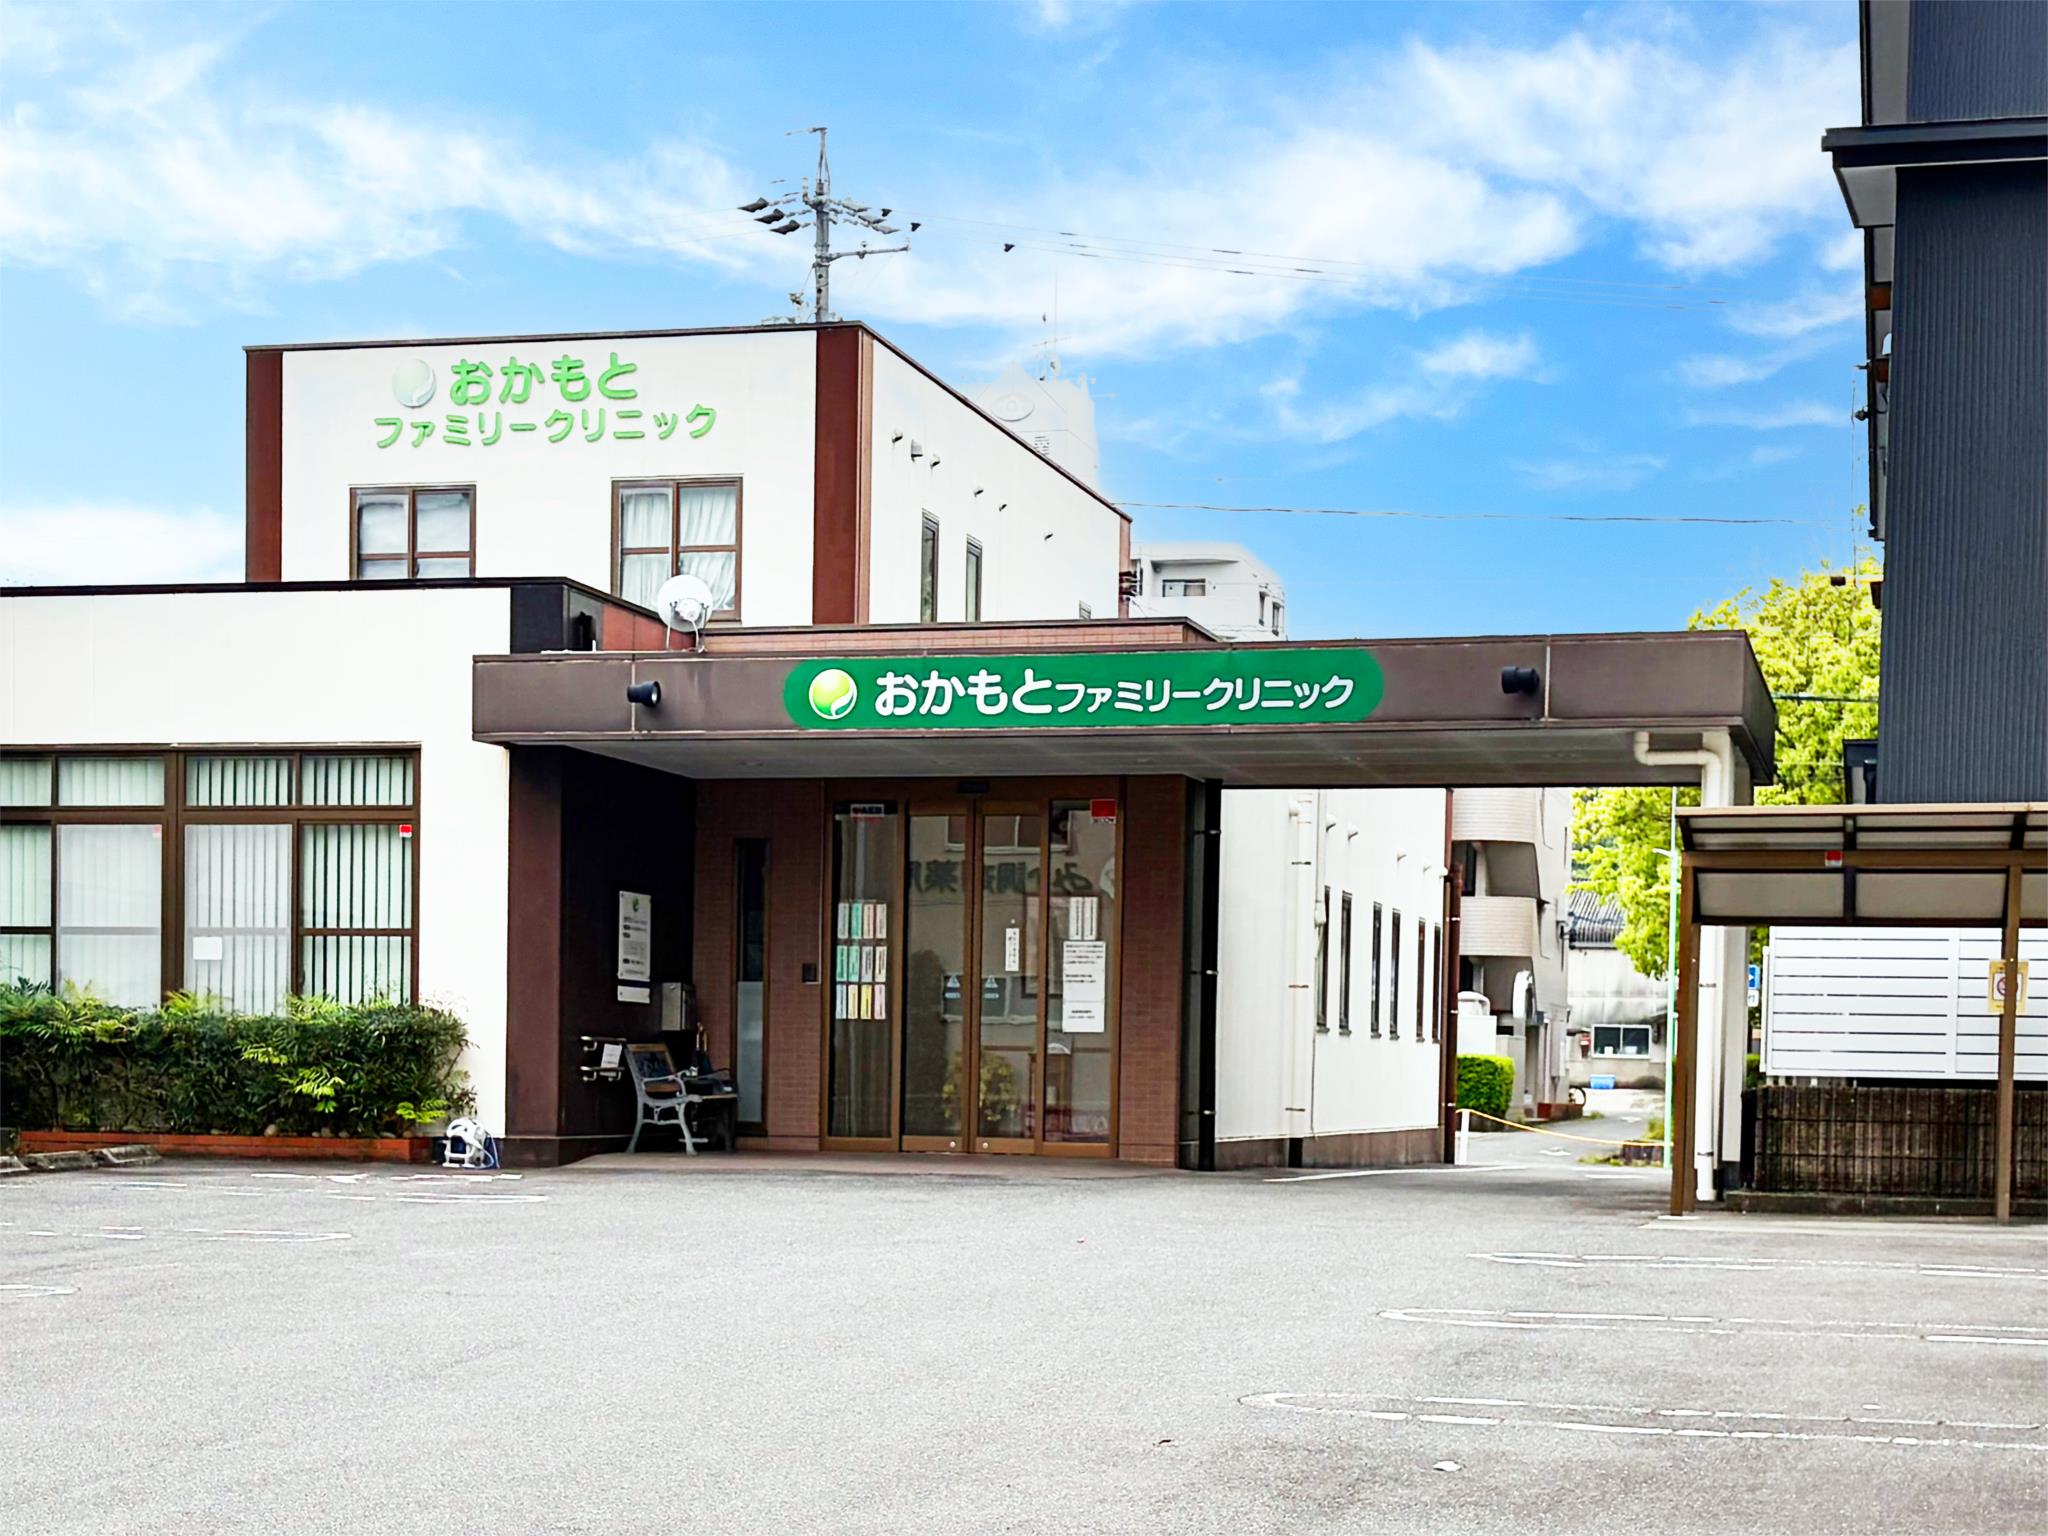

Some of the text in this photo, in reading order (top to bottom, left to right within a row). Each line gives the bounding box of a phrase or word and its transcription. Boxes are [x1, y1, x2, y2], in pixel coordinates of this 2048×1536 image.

[449, 352, 639, 406] おかもと
[373, 403, 717, 449] ファミリークリニック
[874, 668, 1355, 716] おかもとファミリークリニック
